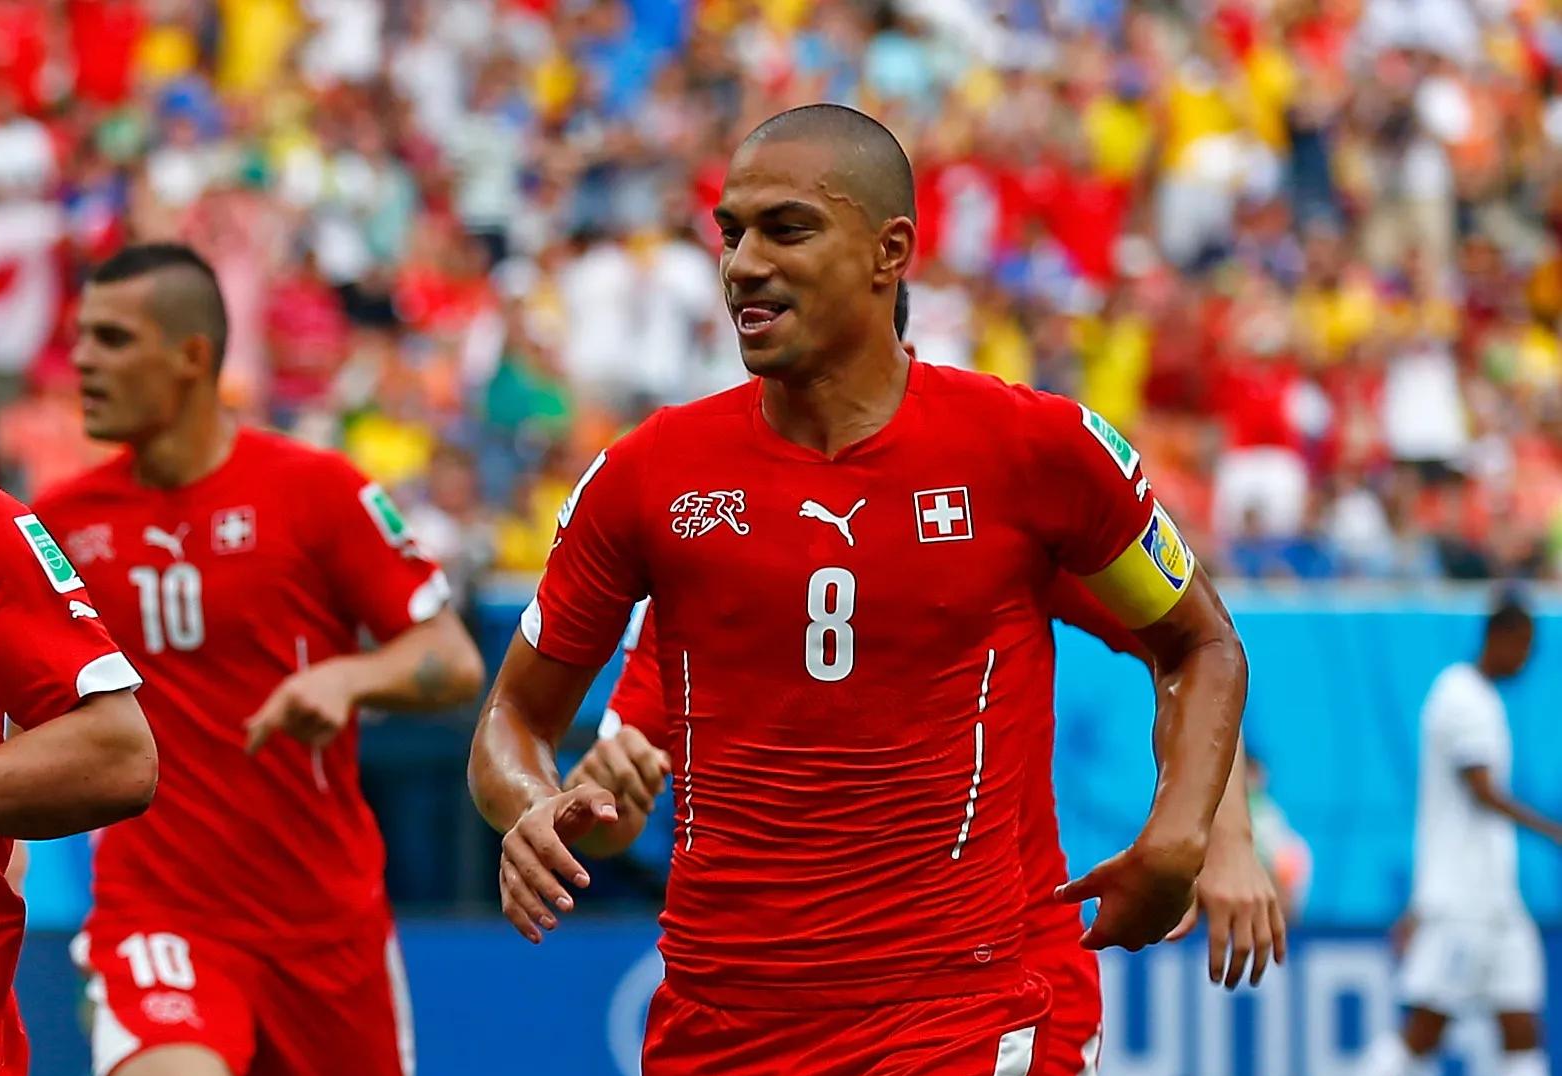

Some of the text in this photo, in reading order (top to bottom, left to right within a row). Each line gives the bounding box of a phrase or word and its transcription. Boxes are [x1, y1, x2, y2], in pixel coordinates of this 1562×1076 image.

[128, 562, 205, 655] 10
[805, 567, 856, 682] 8
[115, 930, 197, 991] 10
